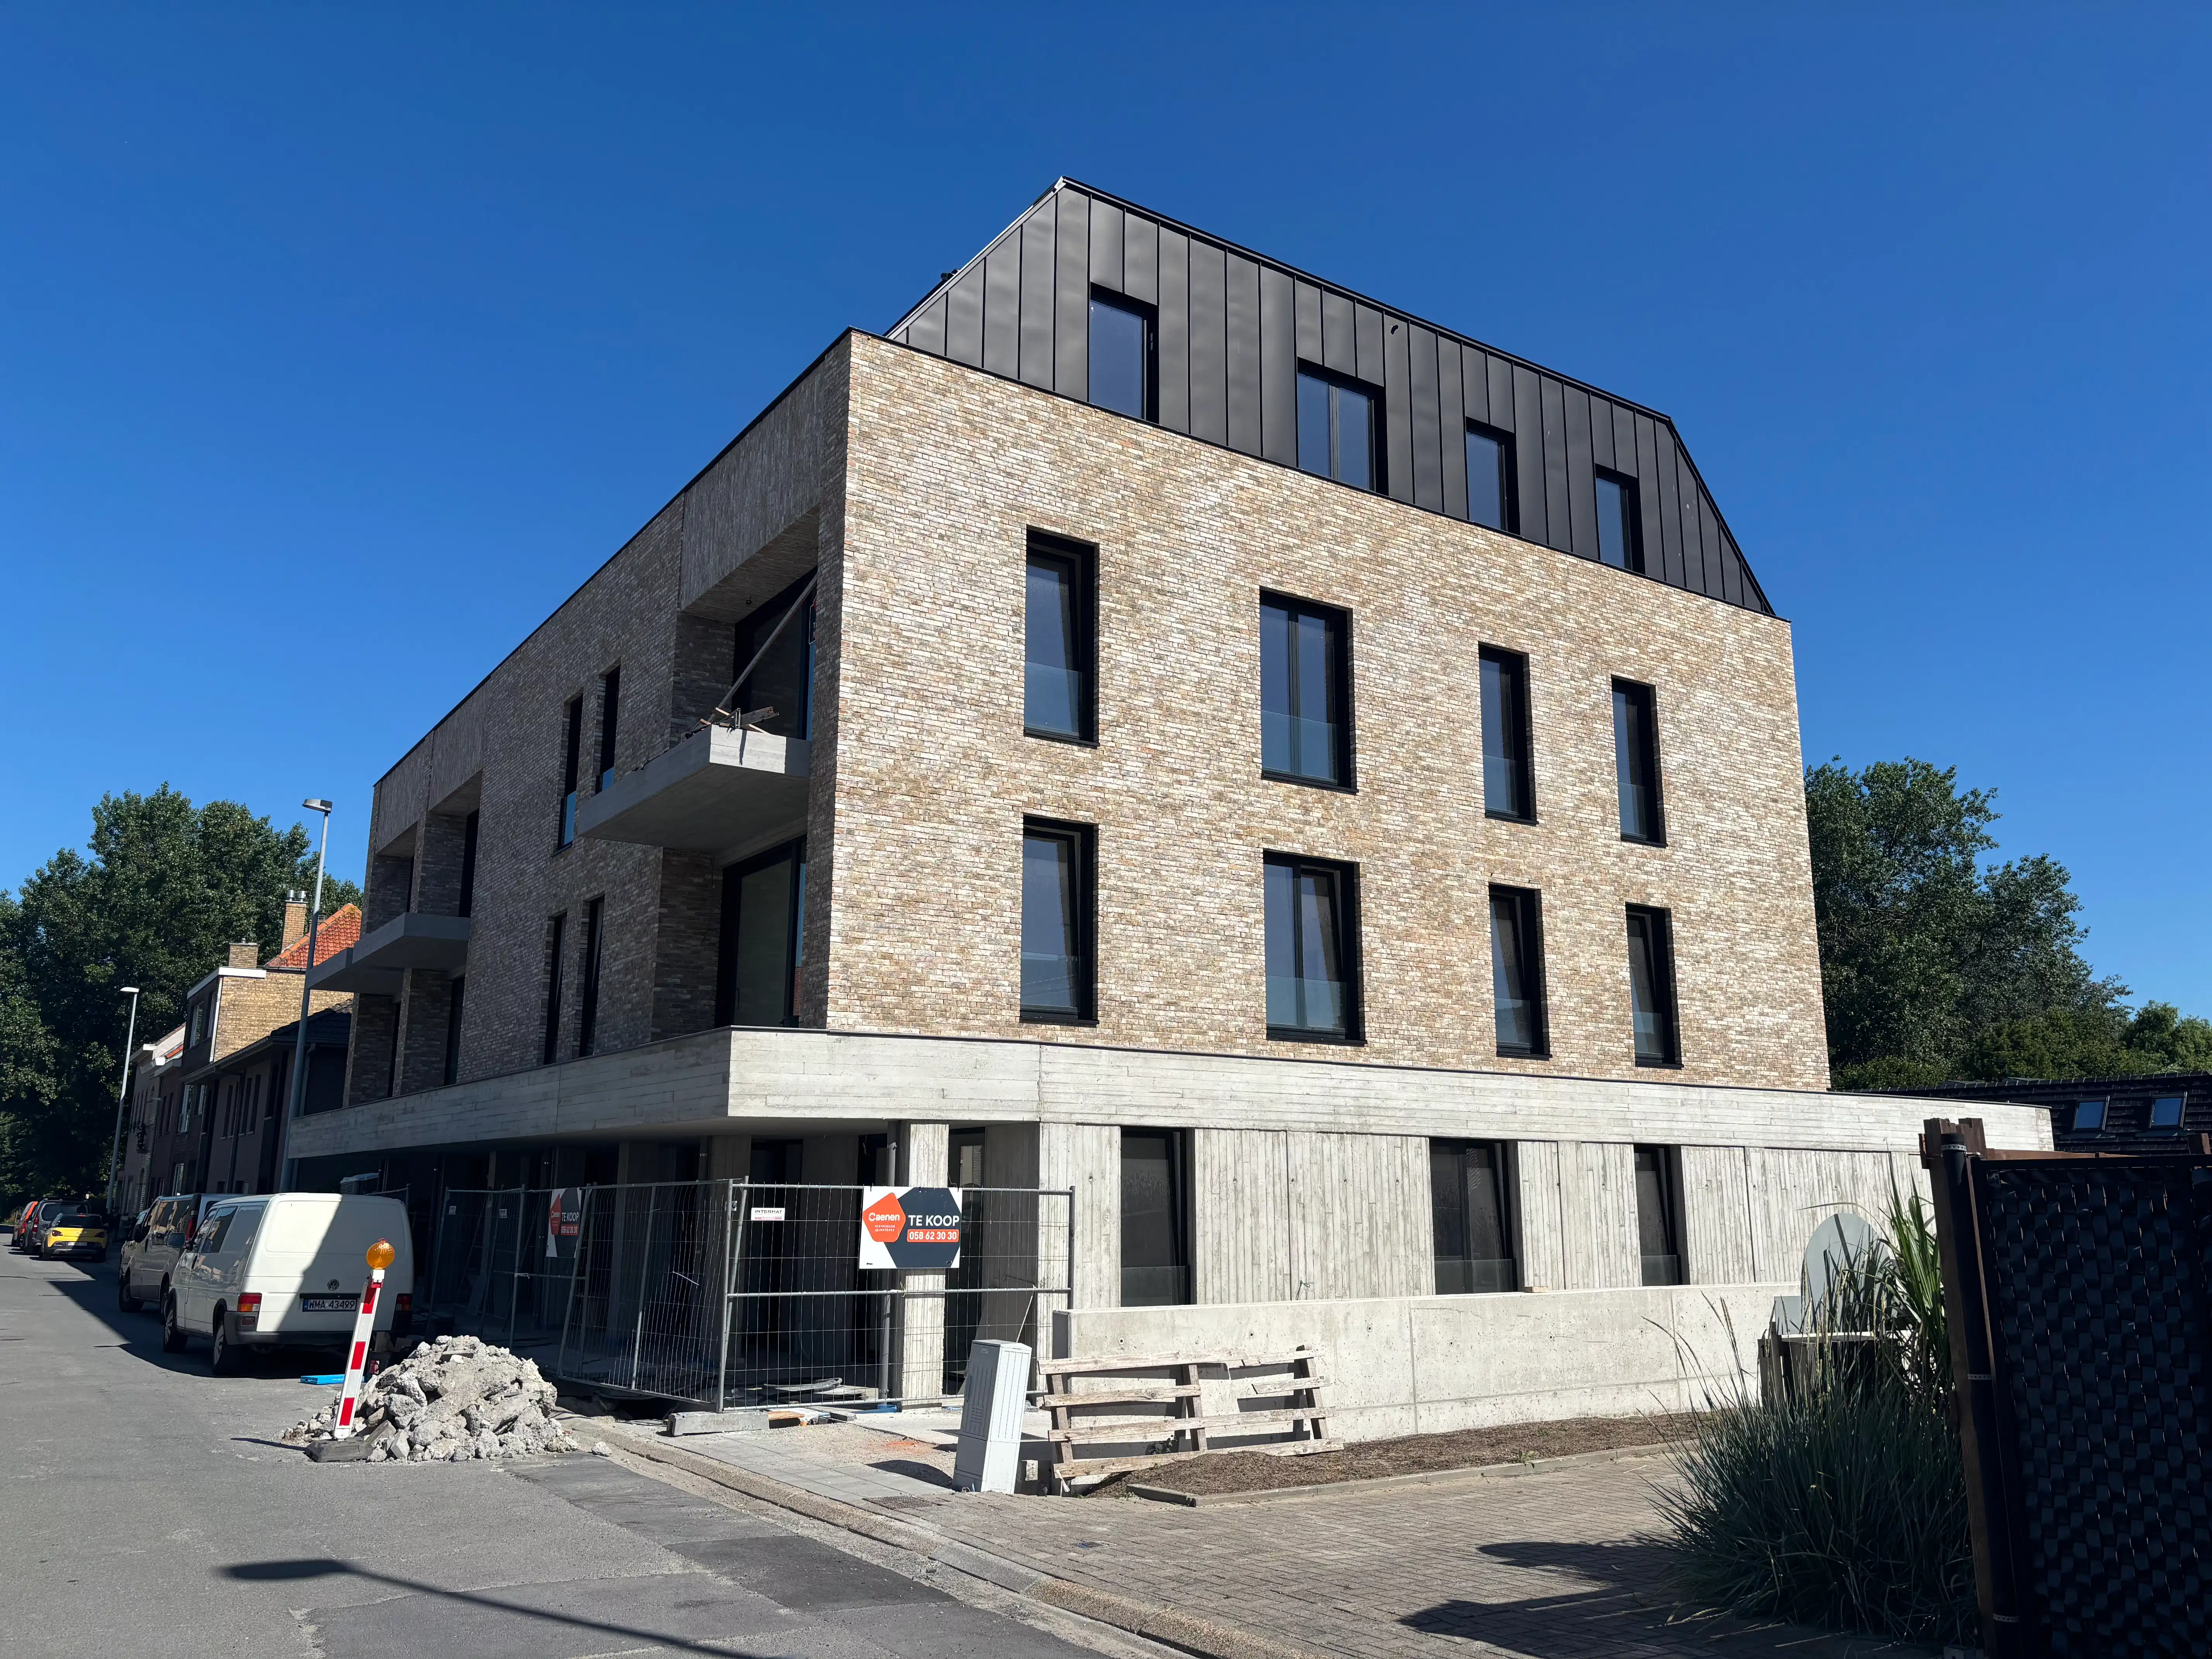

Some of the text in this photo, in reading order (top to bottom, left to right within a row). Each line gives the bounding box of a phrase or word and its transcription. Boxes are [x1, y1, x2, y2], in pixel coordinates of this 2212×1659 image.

[562, 1212, 567, 1221] TE
[567, 1212, 579, 1221] KOOP
[869, 1212, 900, 1221] Caenen
[908, 1215, 960, 1226] TE KOOP
[909, 1231, 957, 1240] 058 62 30 30
[309, 1300, 355, 1309] WMA 43499
